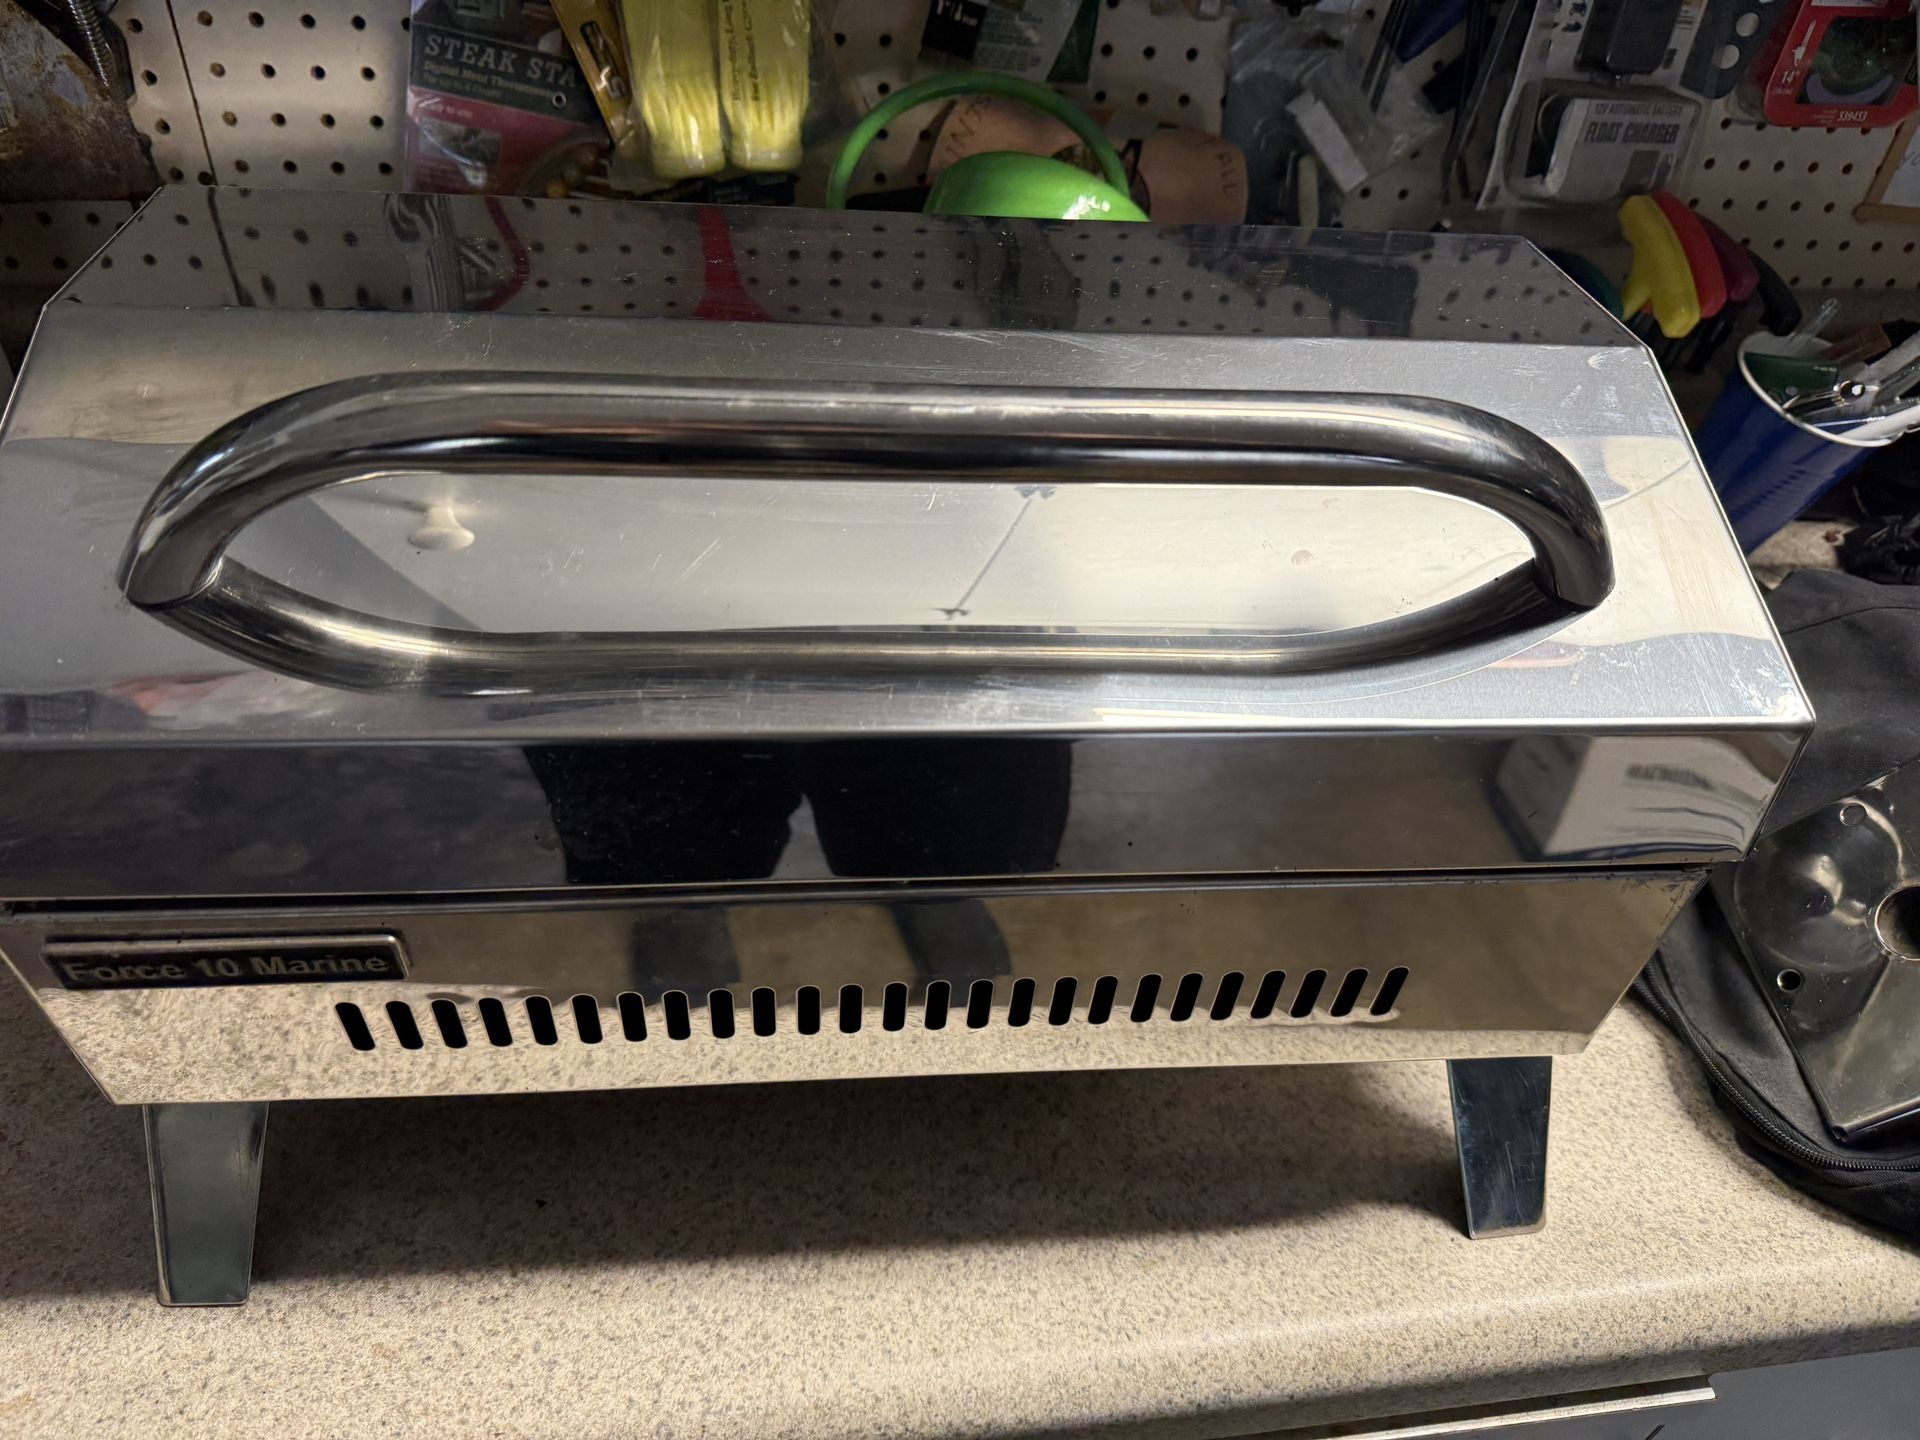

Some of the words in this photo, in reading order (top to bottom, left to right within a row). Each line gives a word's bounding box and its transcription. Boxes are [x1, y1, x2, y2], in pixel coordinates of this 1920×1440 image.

[424, 34, 519, 73] STEAK
[1584, 121, 1623, 143] FLOAT
[1622, 122, 1681, 145] CHARGER
[62, 959, 187, 983] Force
[192, 957, 241, 979] 10
[250, 952, 390, 977] Marine
